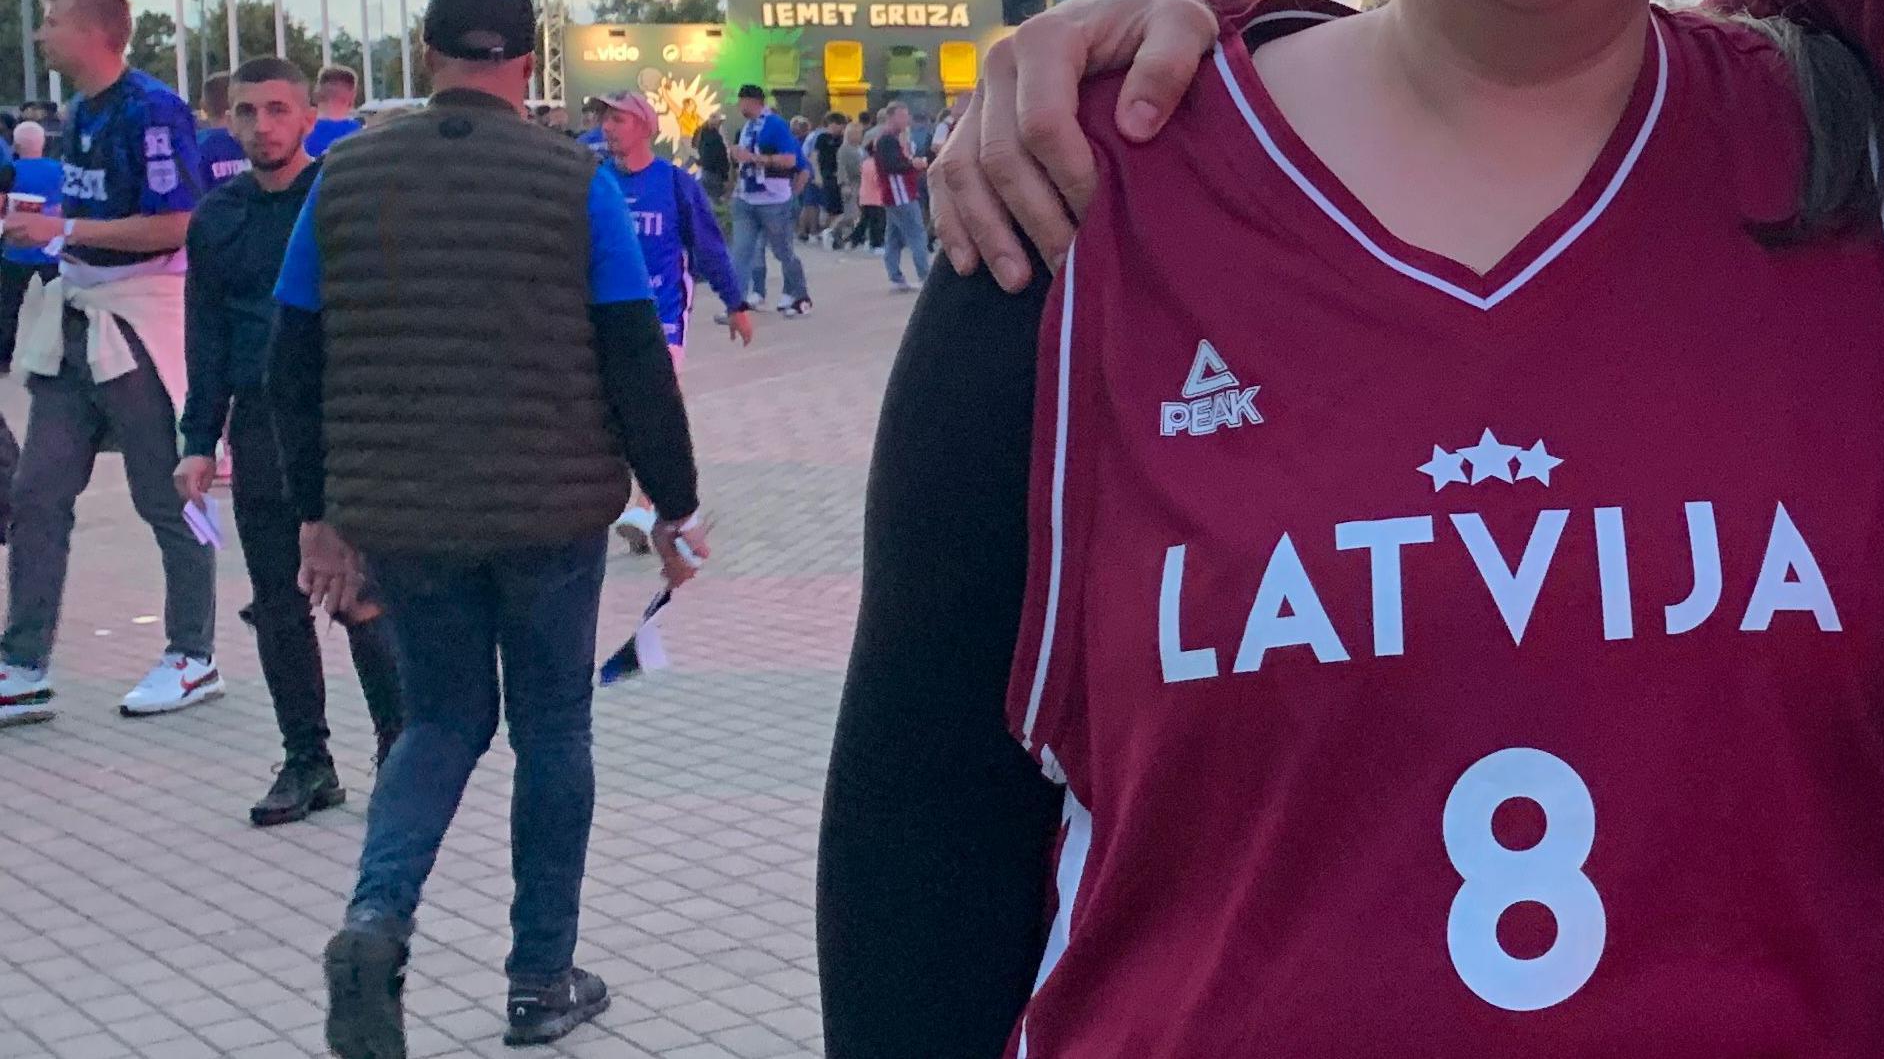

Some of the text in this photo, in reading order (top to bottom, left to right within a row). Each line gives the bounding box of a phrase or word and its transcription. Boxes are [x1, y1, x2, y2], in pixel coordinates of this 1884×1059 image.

[764, 4, 857, 27] IEMET
[1160, 384, 1265, 437] PEAK
[1158, 501, 1843, 683] LATVIJA
[1443, 747, 1606, 1011] 8
